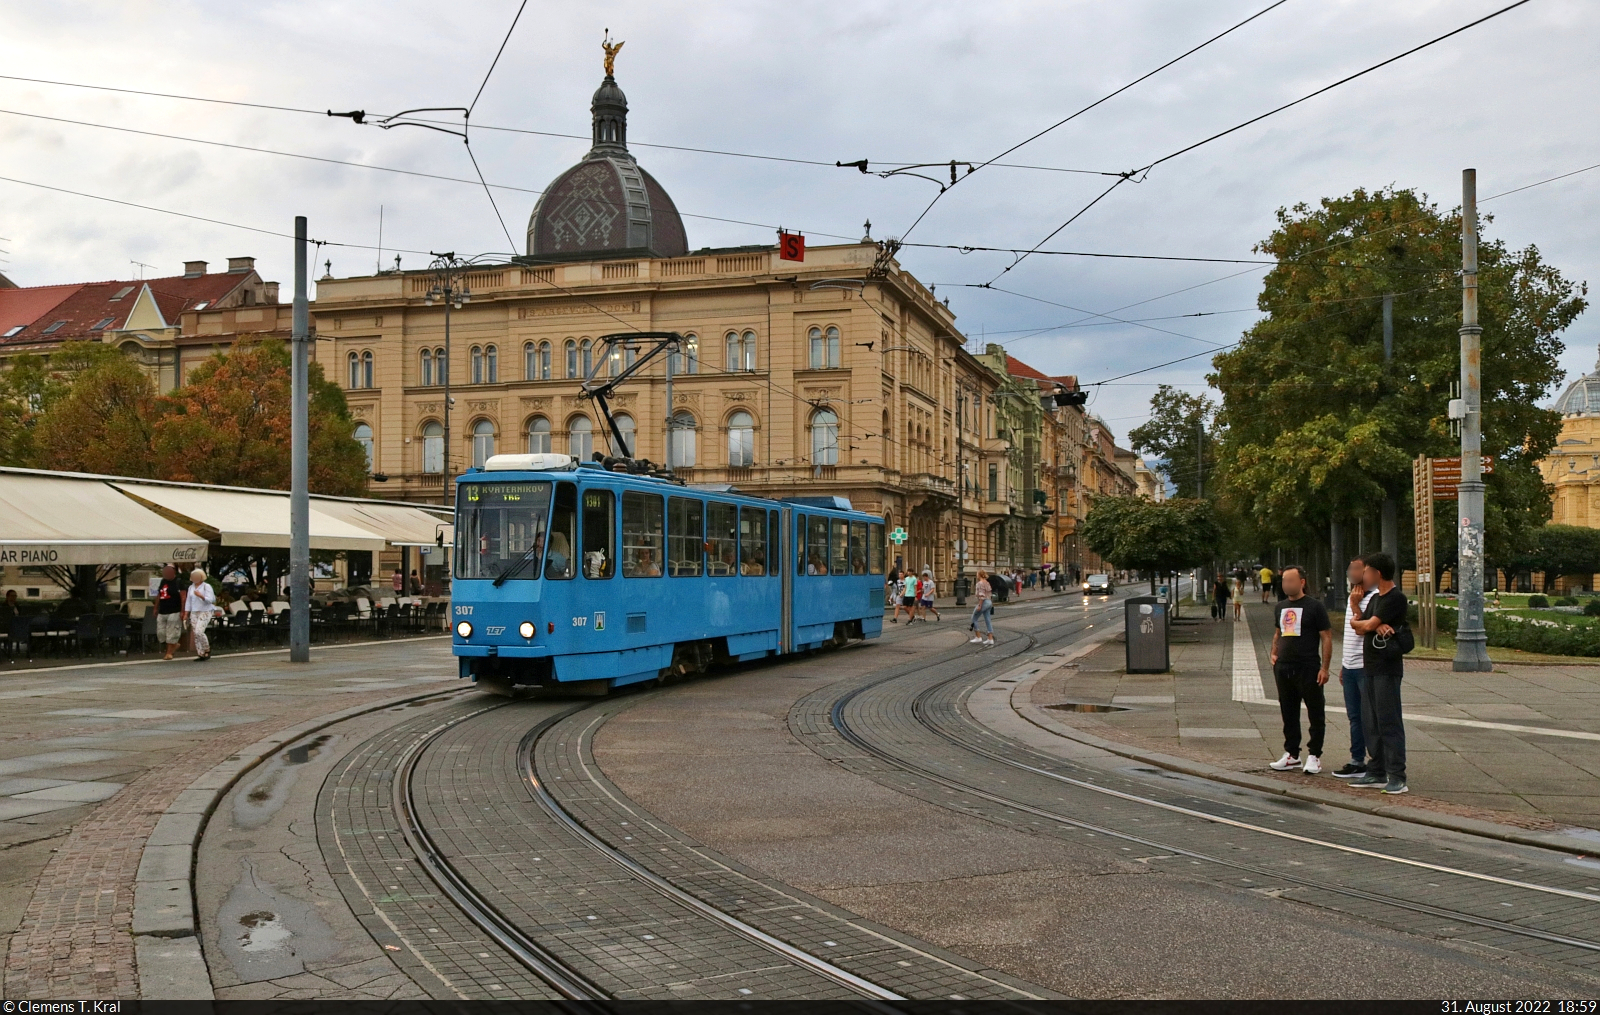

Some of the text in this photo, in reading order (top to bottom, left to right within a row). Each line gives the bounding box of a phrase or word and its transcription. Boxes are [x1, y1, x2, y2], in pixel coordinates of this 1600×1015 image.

[787, 237, 799, 258] S
[466, 485, 544, 501] 13 KVATERNIKOV
[21, 550, 58, 562] PIANO
[455, 606, 474, 616] 307
[572, 617, 588, 627] 307
[486, 626, 507, 636] ZET
